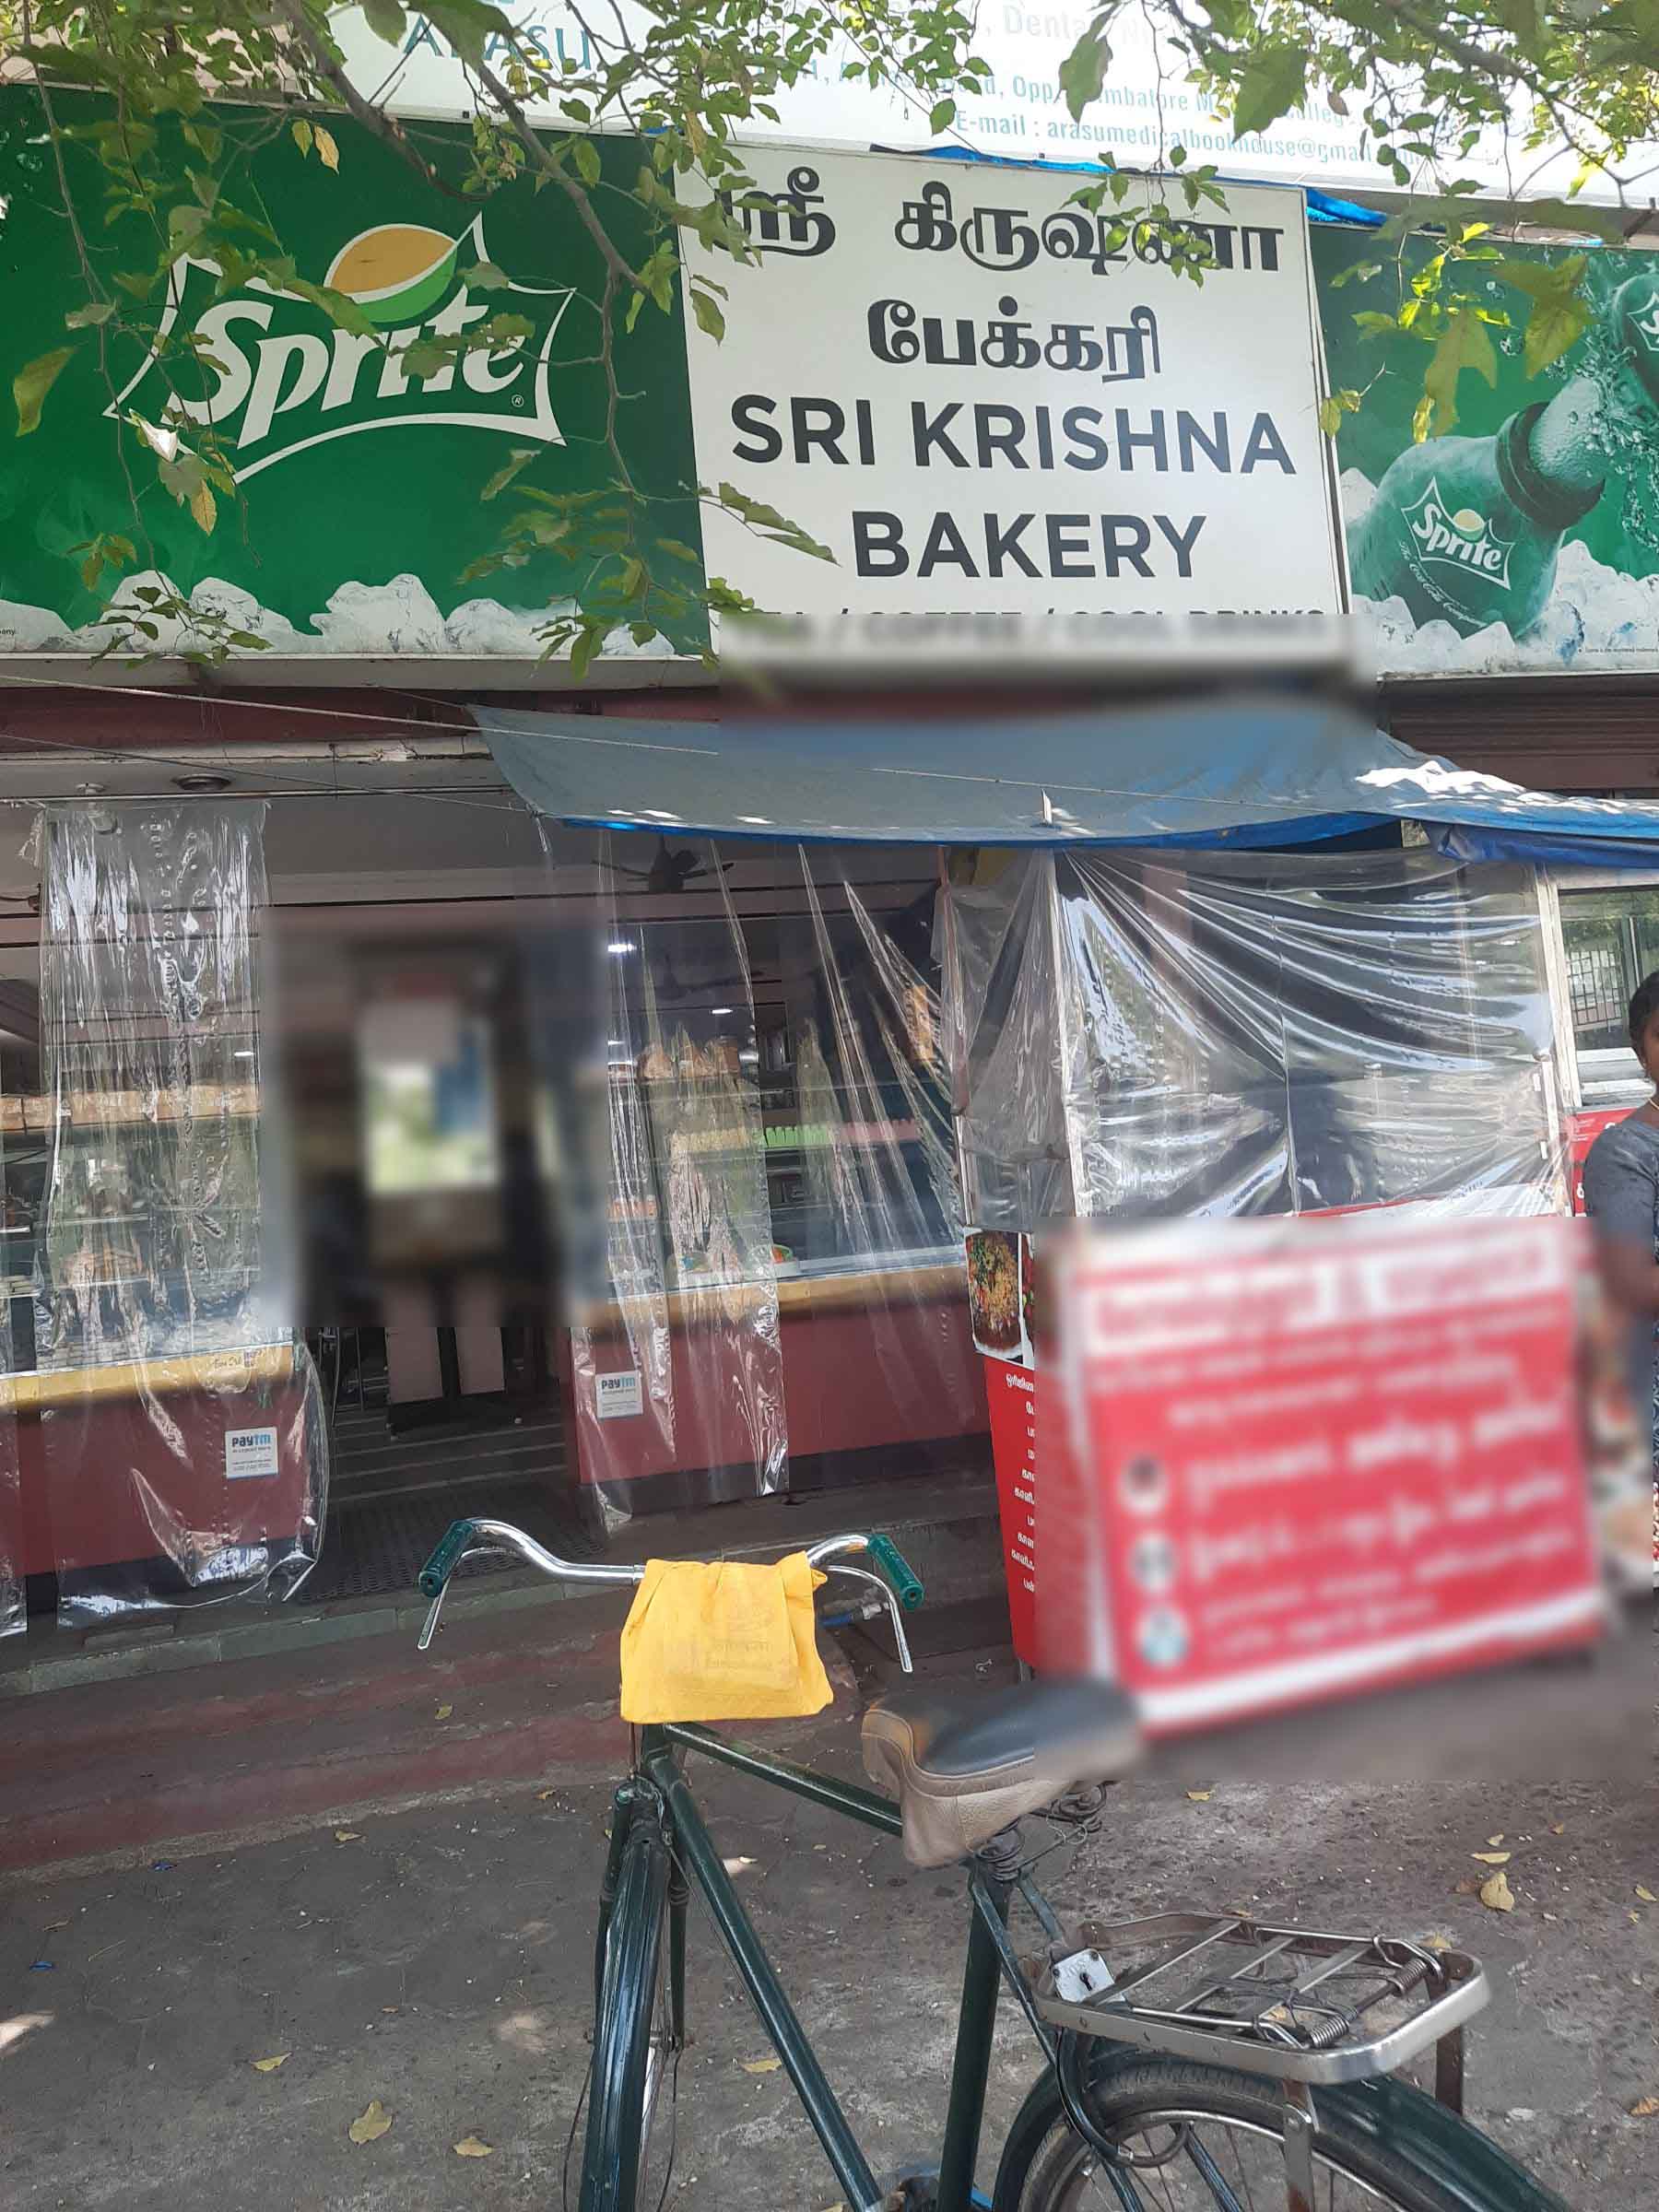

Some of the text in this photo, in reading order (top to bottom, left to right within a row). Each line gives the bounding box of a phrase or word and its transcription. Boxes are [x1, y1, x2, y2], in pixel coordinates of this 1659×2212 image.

[403, 14, 591, 70] AASU
[167, 285, 525, 450] Sprite
[867, 296, 1160, 383] பேக்கரி
[730, 394, 1297, 475] SRI KRISHNA
[852, 510, 1206, 579] BAKERY
[1412, 503, 1502, 571] Sprite
